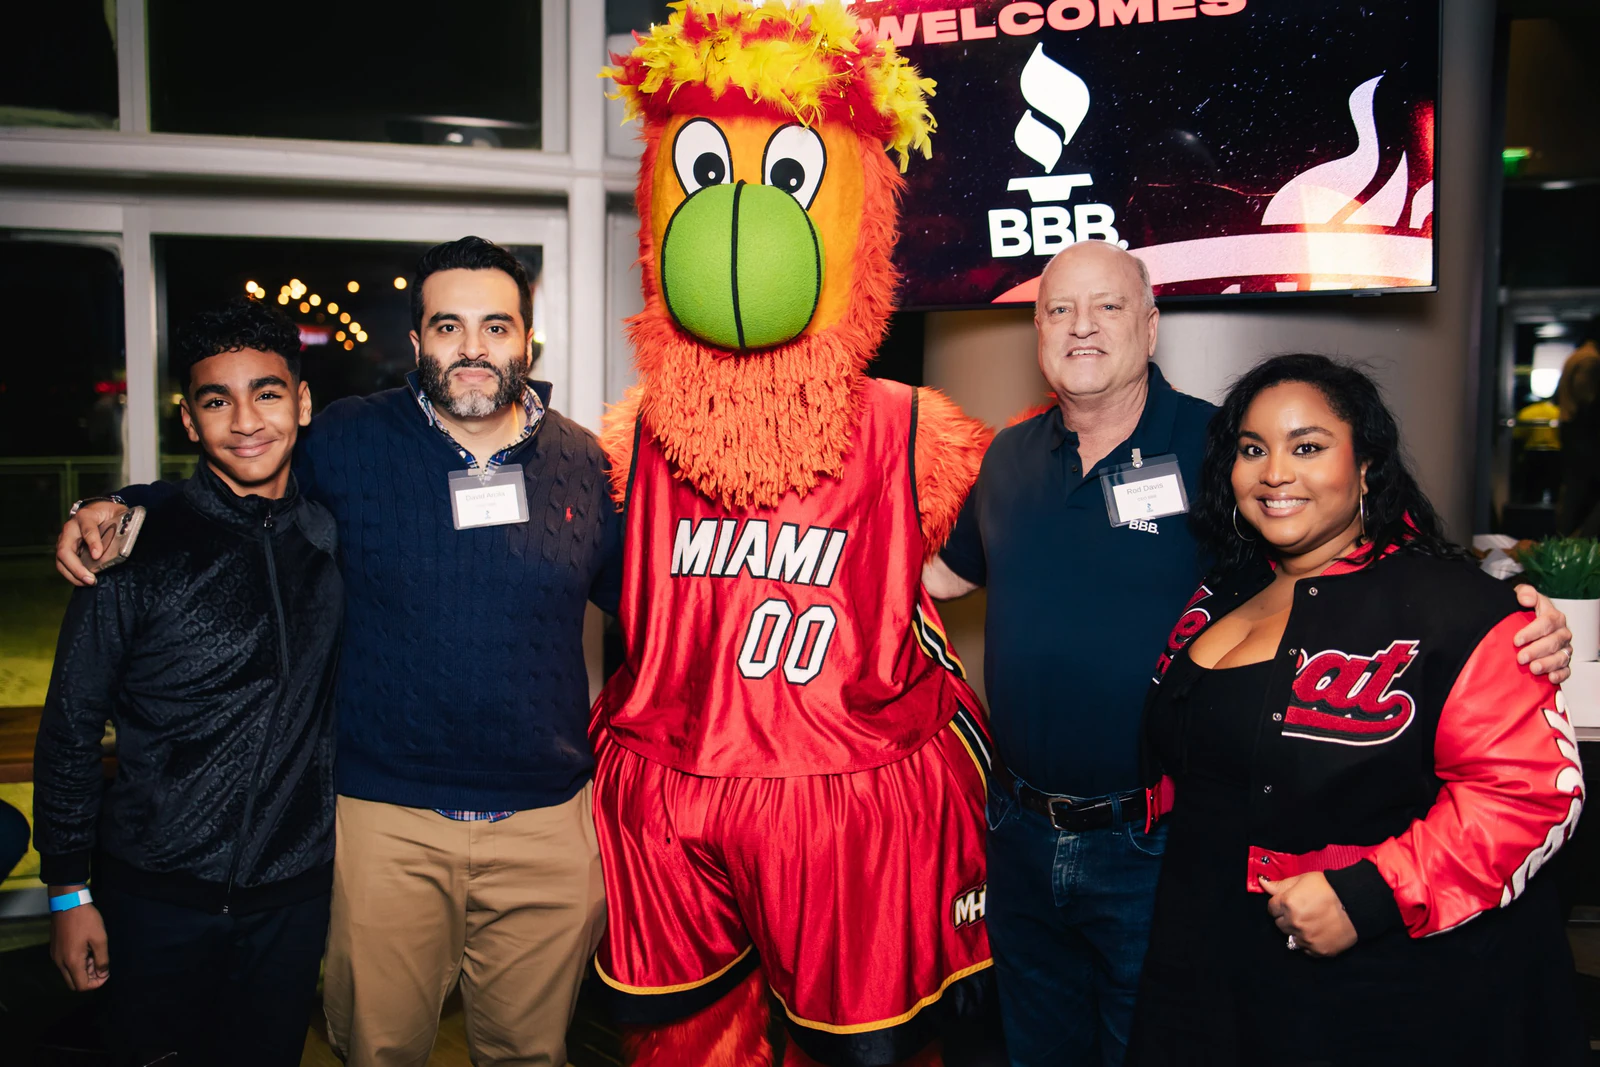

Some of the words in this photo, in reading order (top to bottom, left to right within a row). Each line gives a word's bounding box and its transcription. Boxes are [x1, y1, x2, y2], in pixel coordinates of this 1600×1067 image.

[859, 0, 1248, 47] WELCOMES
[465, 493, 485, 501] David
[1127, 487, 1142, 495] Rod
[1143, 483, 1163, 491] Davis
[670, 518, 848, 588] MIAMI
[737, 598, 837, 686] 00
